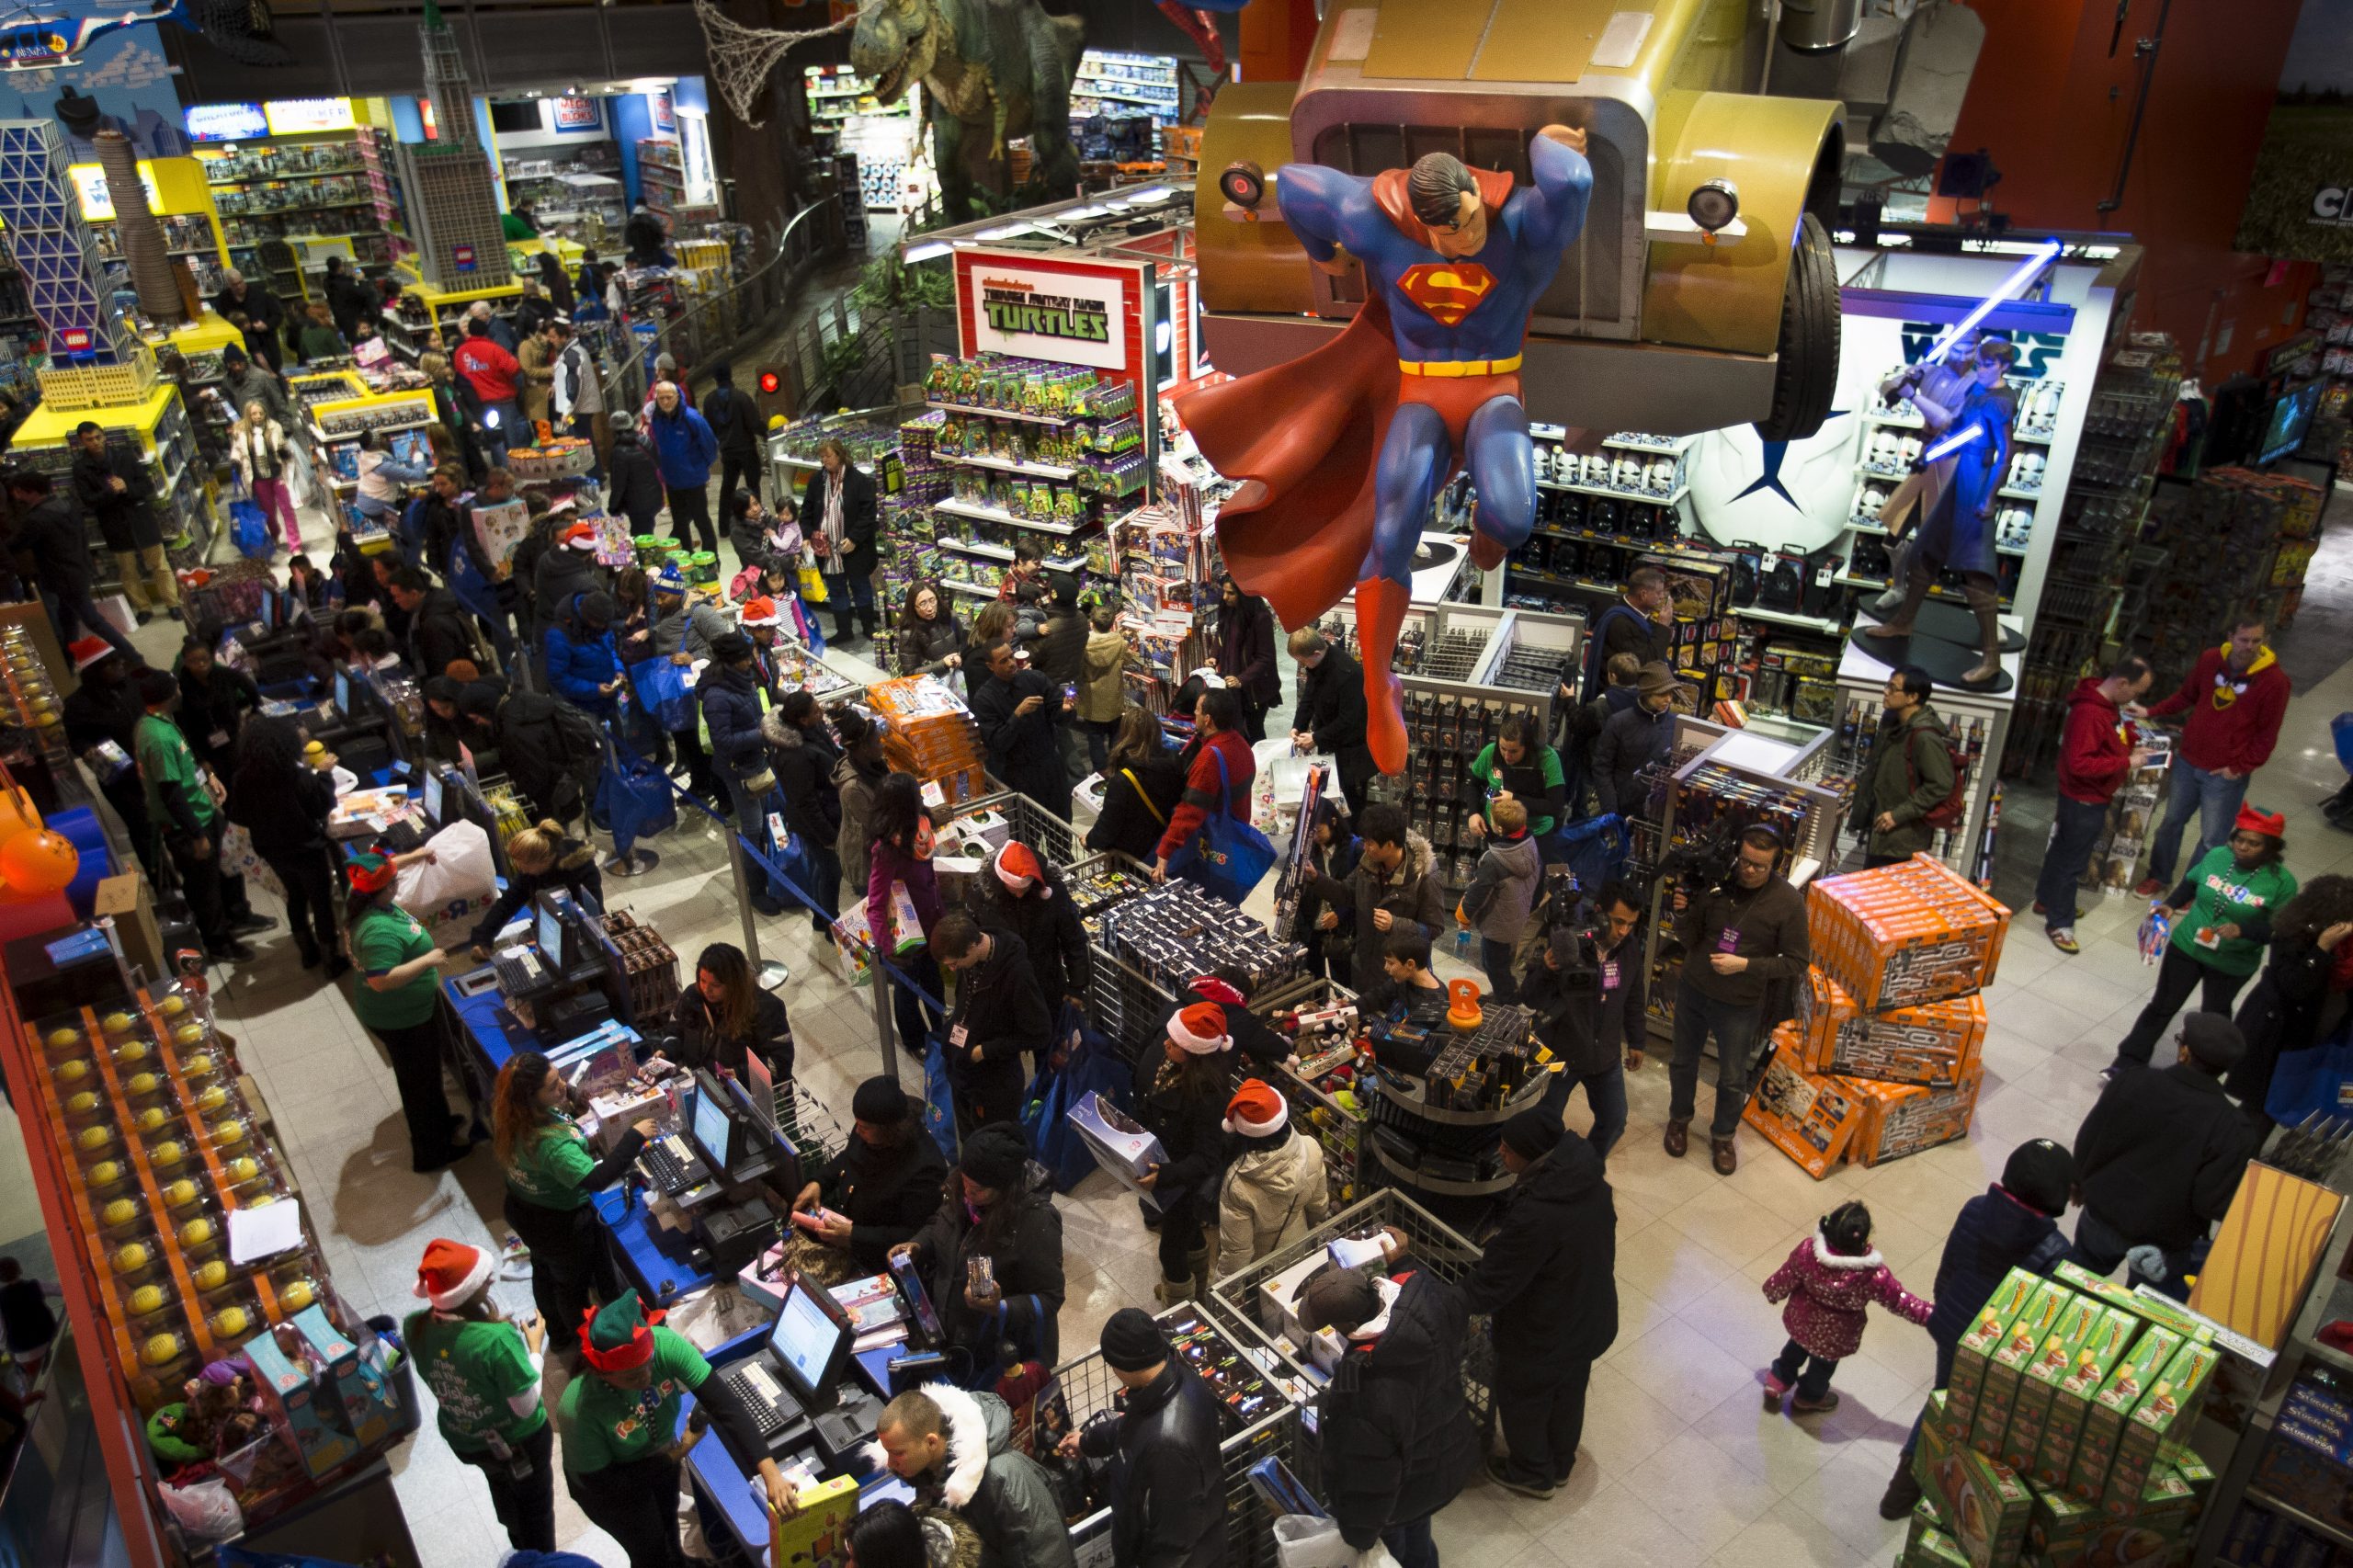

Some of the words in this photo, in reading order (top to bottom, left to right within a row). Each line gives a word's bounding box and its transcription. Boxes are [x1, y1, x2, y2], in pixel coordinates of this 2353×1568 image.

[561, 98, 593, 108] MEGA
[562, 111, 594, 122] BLOKS
[983, 299, 1108, 344] TURTLES
[66, 333, 89, 346] LEGO
[1167, 602, 1188, 611] sale
